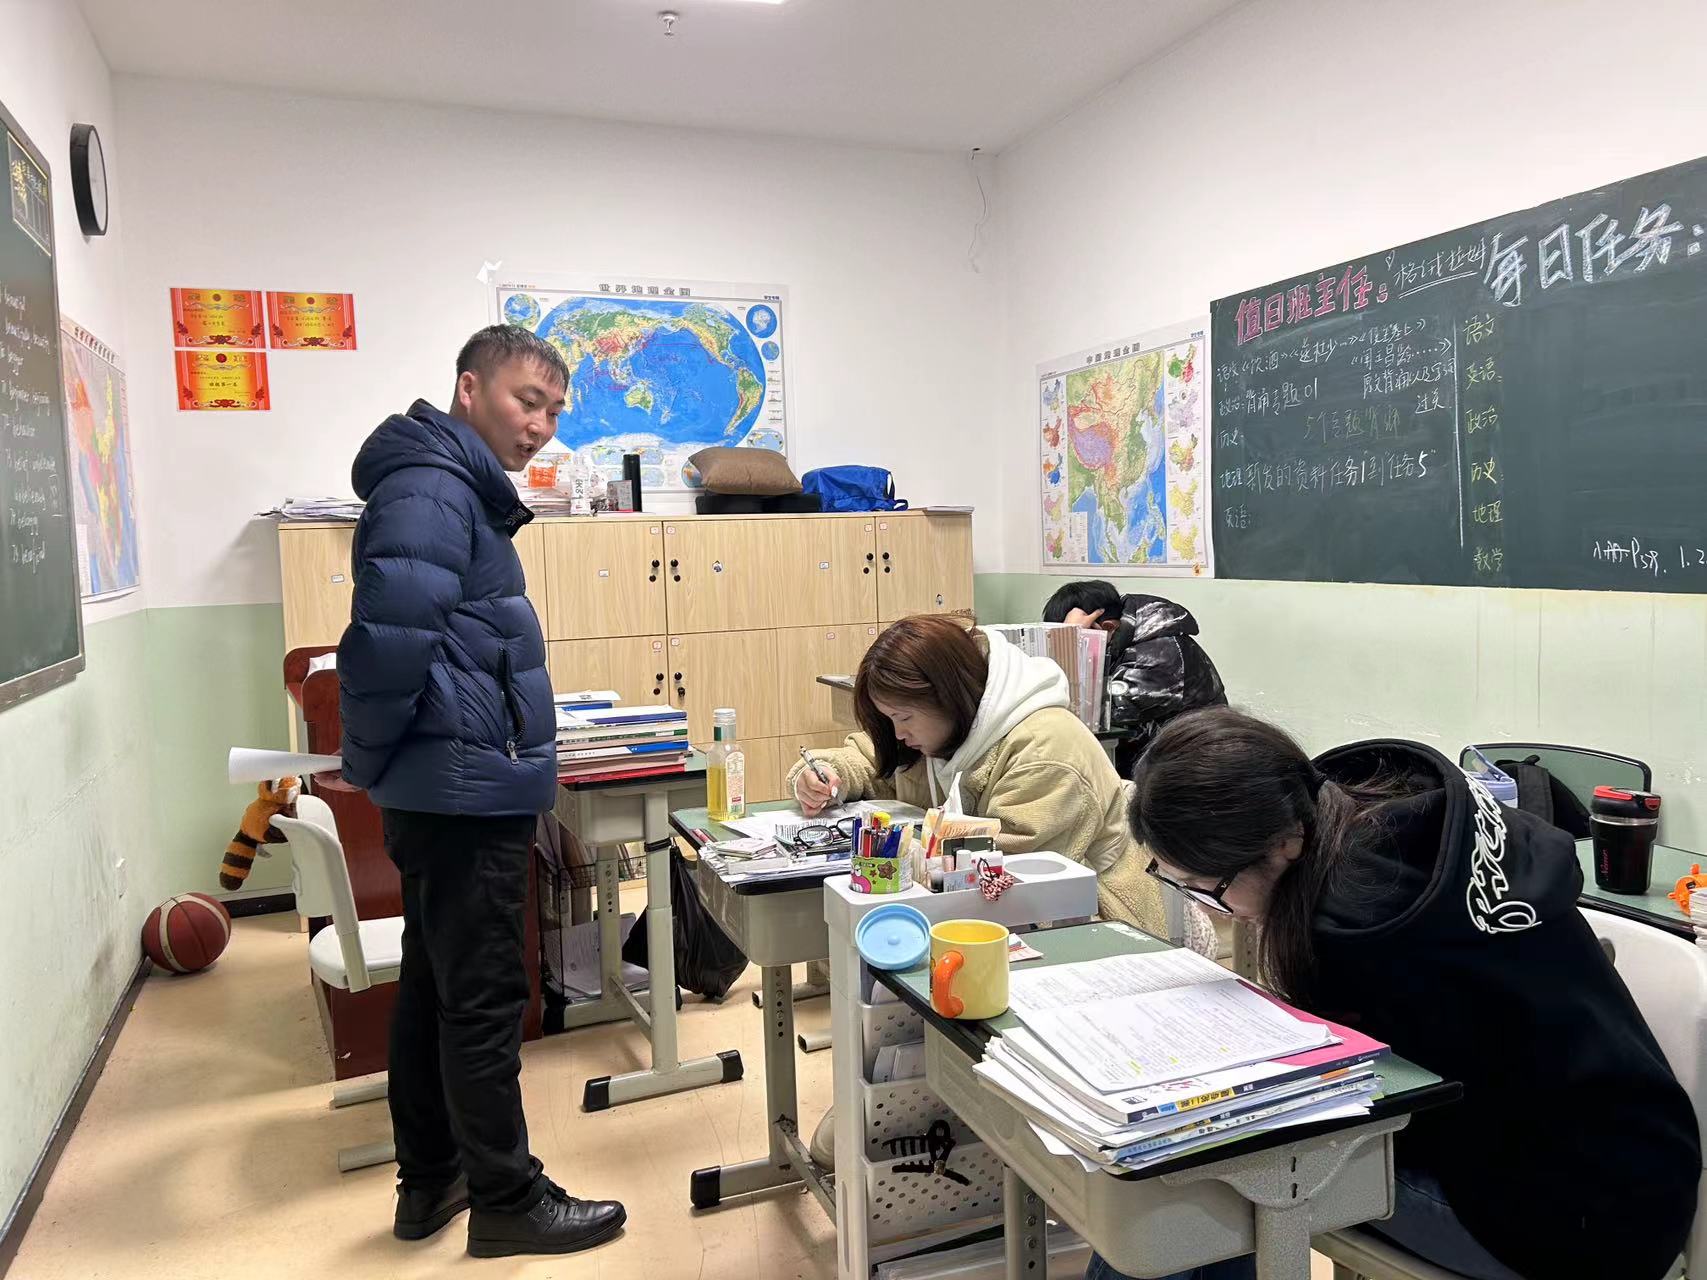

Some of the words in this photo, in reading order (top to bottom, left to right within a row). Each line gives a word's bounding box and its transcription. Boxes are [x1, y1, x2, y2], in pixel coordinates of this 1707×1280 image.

[598, 283, 691, 297] 世界地理全图
[1472, 500, 1504, 524] 地理
